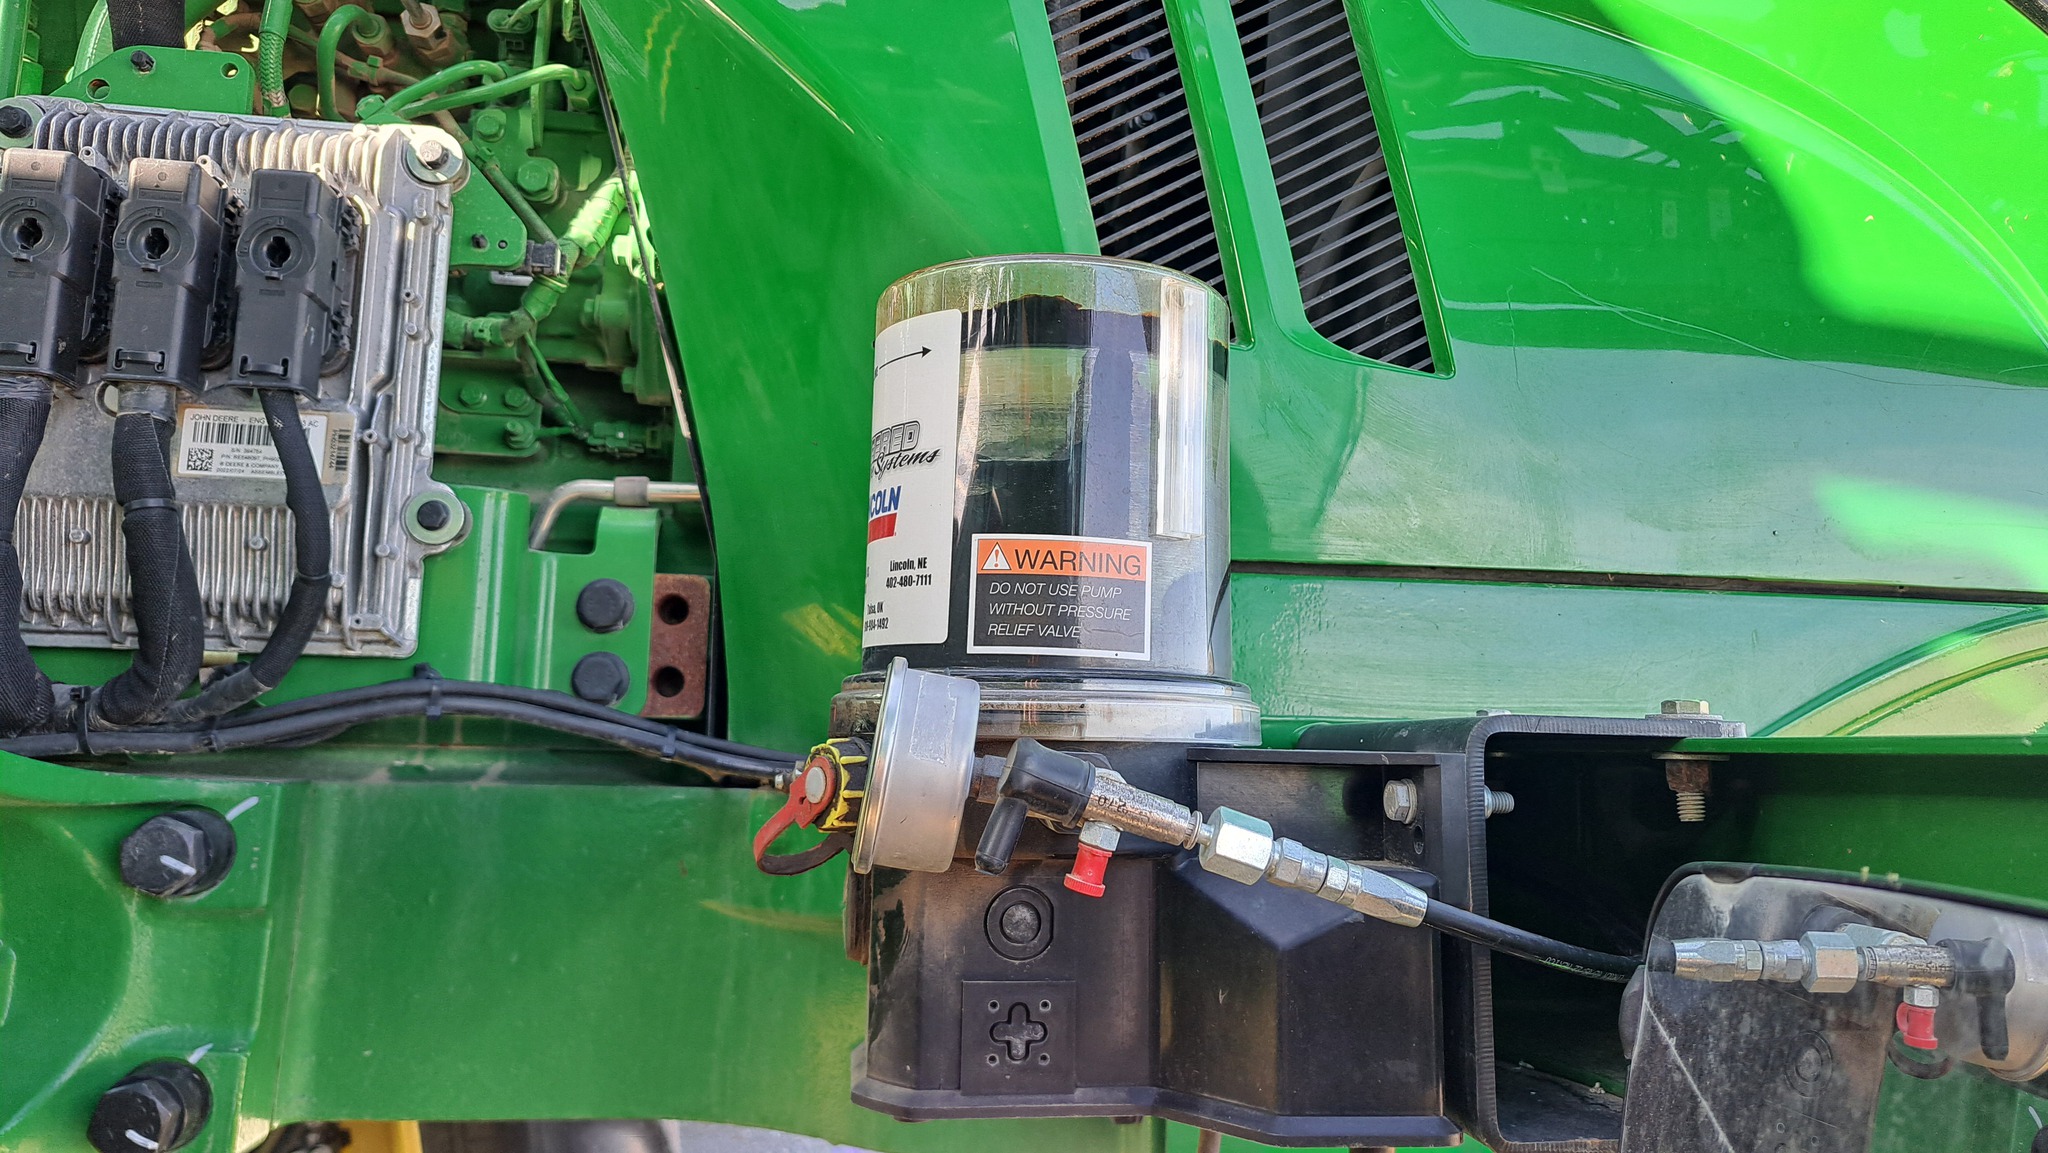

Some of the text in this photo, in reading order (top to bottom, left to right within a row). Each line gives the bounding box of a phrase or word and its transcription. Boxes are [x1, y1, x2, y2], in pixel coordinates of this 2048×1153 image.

[190, 414, 212, 422] JOHN
[213, 415, 239, 423] DEERE
[889, 556, 928, 572] Lincoln, NE
[1014, 549, 1142, 576] WARNING
[885, 574, 932, 589] 402-480-7111
[989, 582, 1122, 599] DO NOT USE PUMP
[989, 602, 1132, 621] WITHOUT PRESSURE
[987, 623, 1082, 638] RELIEF VALVE
